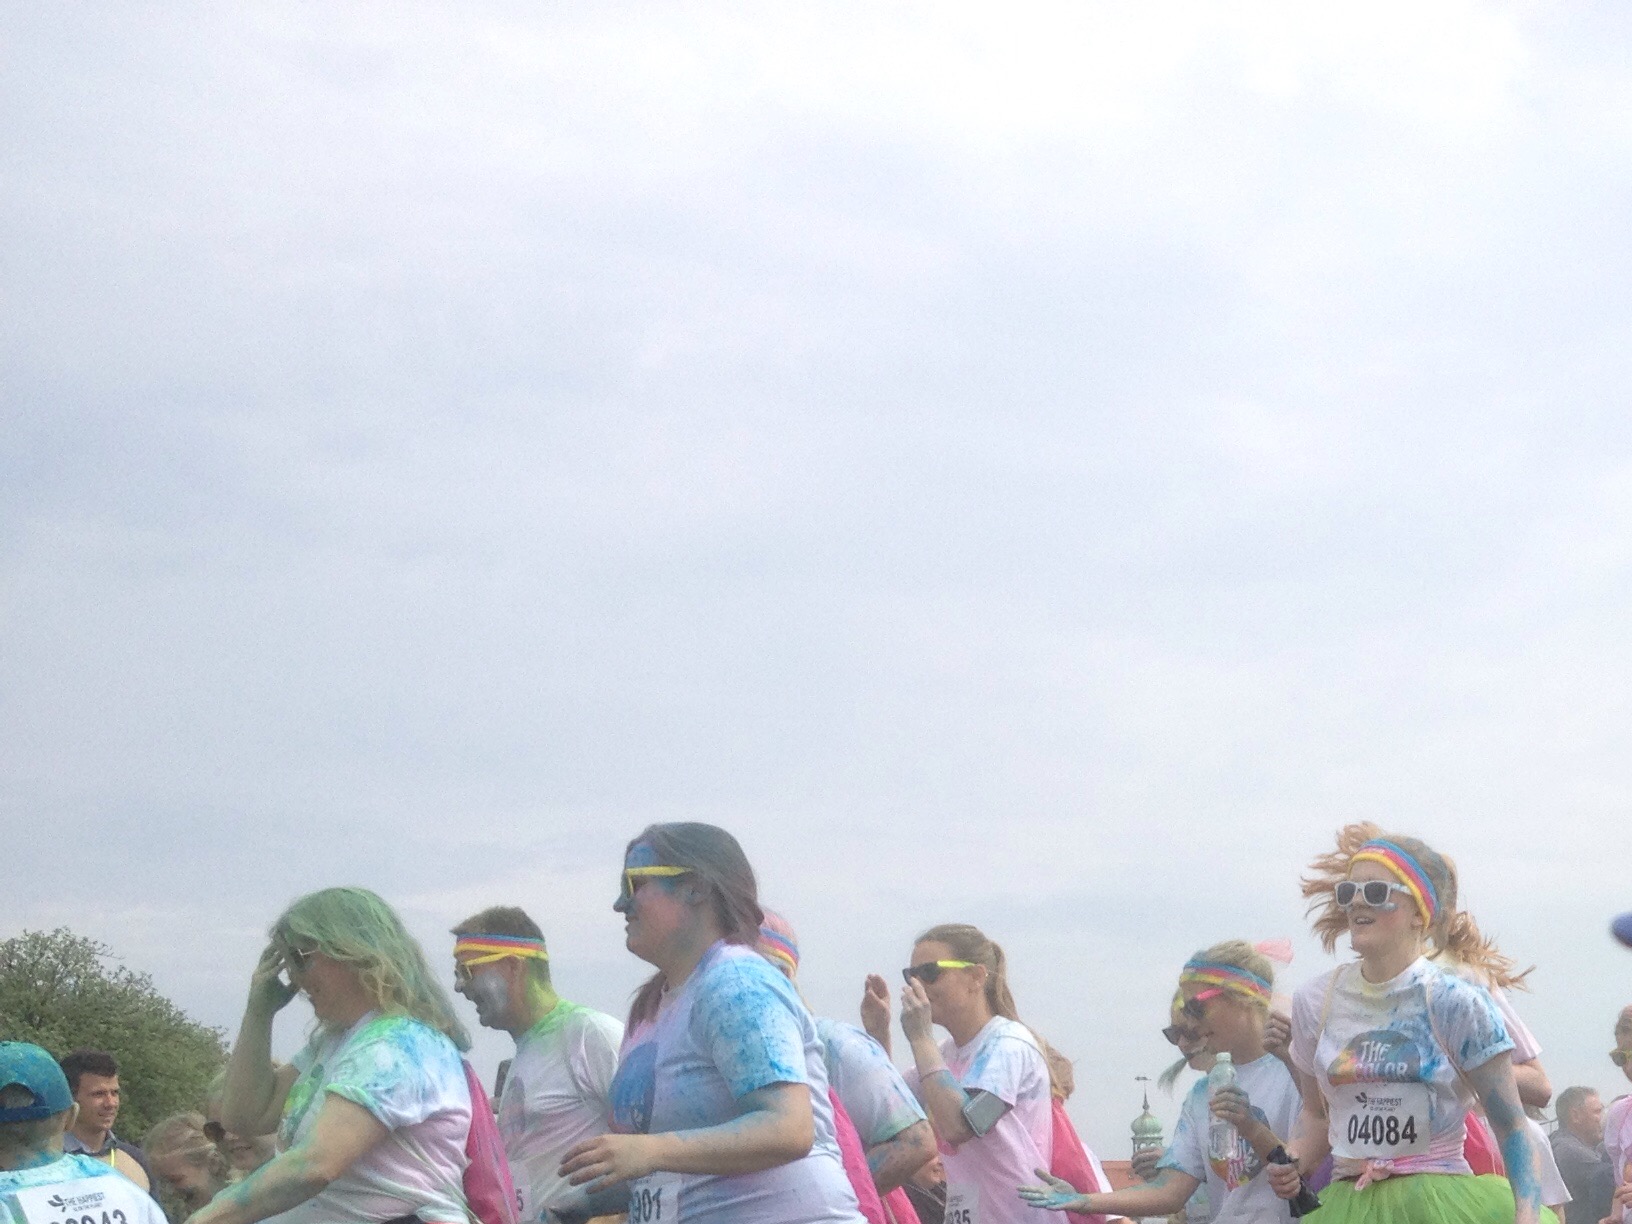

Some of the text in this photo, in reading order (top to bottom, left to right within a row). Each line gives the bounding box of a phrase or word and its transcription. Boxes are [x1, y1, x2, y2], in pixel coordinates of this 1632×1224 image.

[1359, 1040, 1393, 1063] THE
[1347, 1114, 1418, 1146] 04084
[629, 1187, 663, 1224] 901
